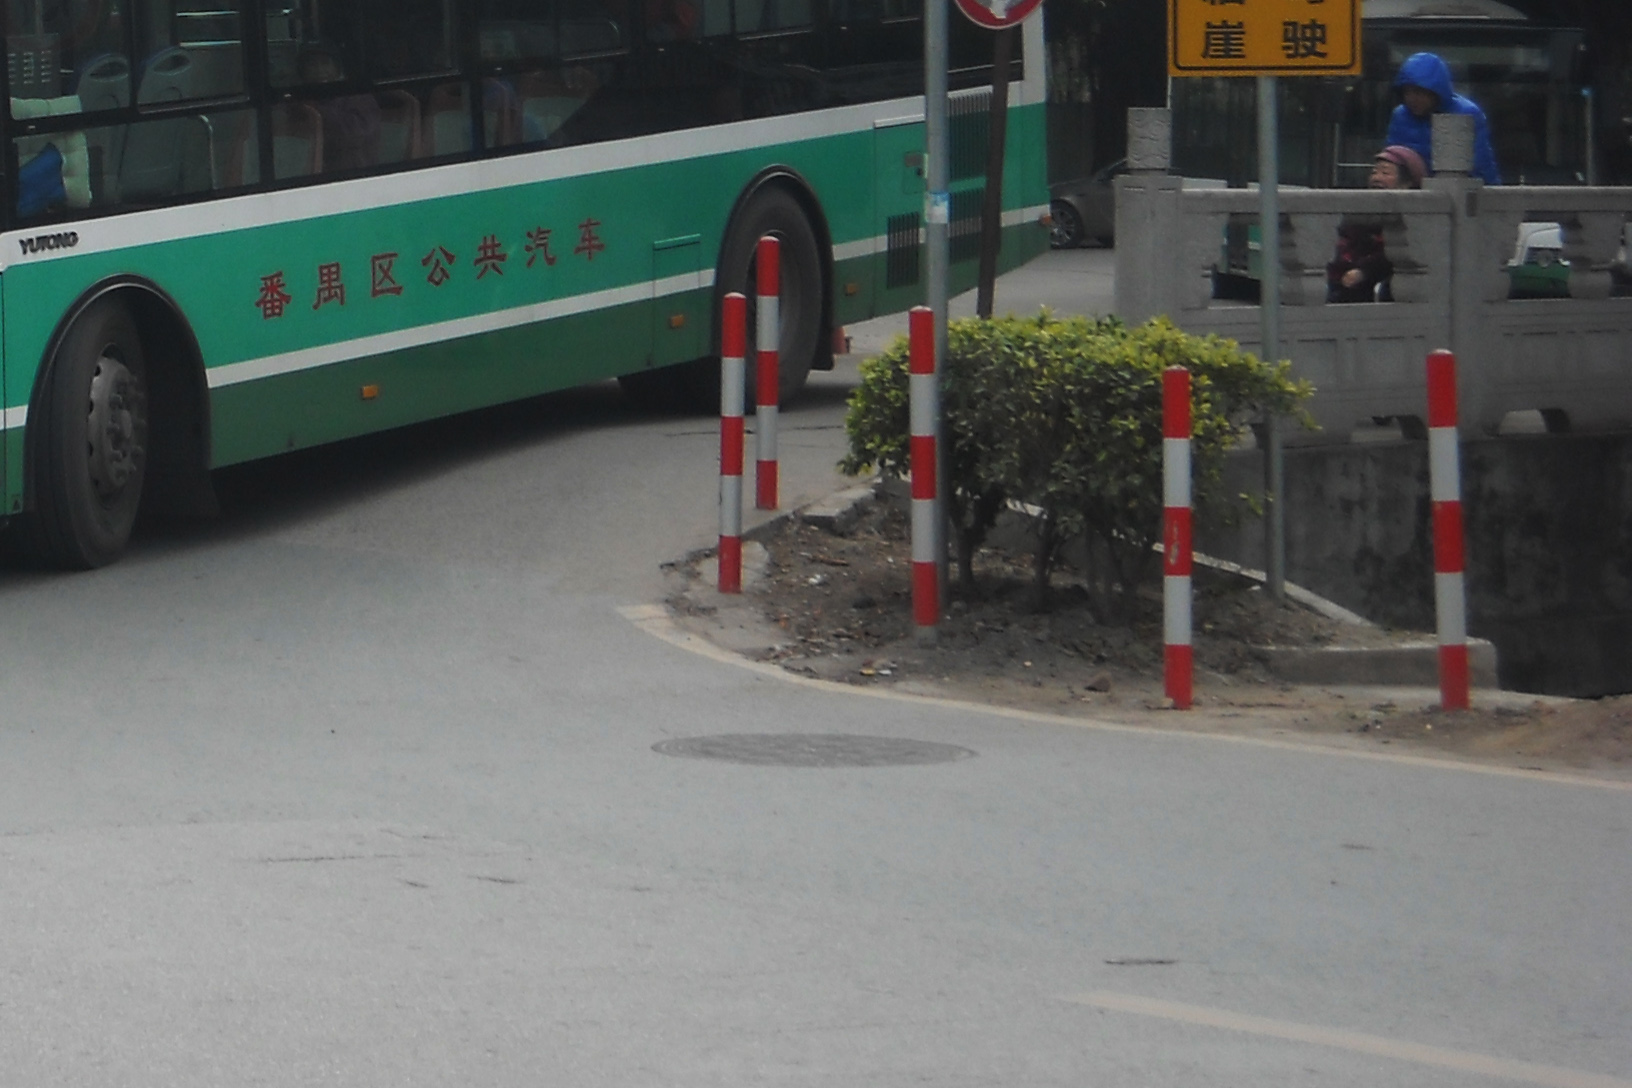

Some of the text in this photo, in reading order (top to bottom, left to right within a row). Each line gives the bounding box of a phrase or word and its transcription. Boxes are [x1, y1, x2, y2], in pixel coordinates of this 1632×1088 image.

[18, 231, 80, 255] YUTONG
[255, 217, 606, 320] 番禺区公共汽车
